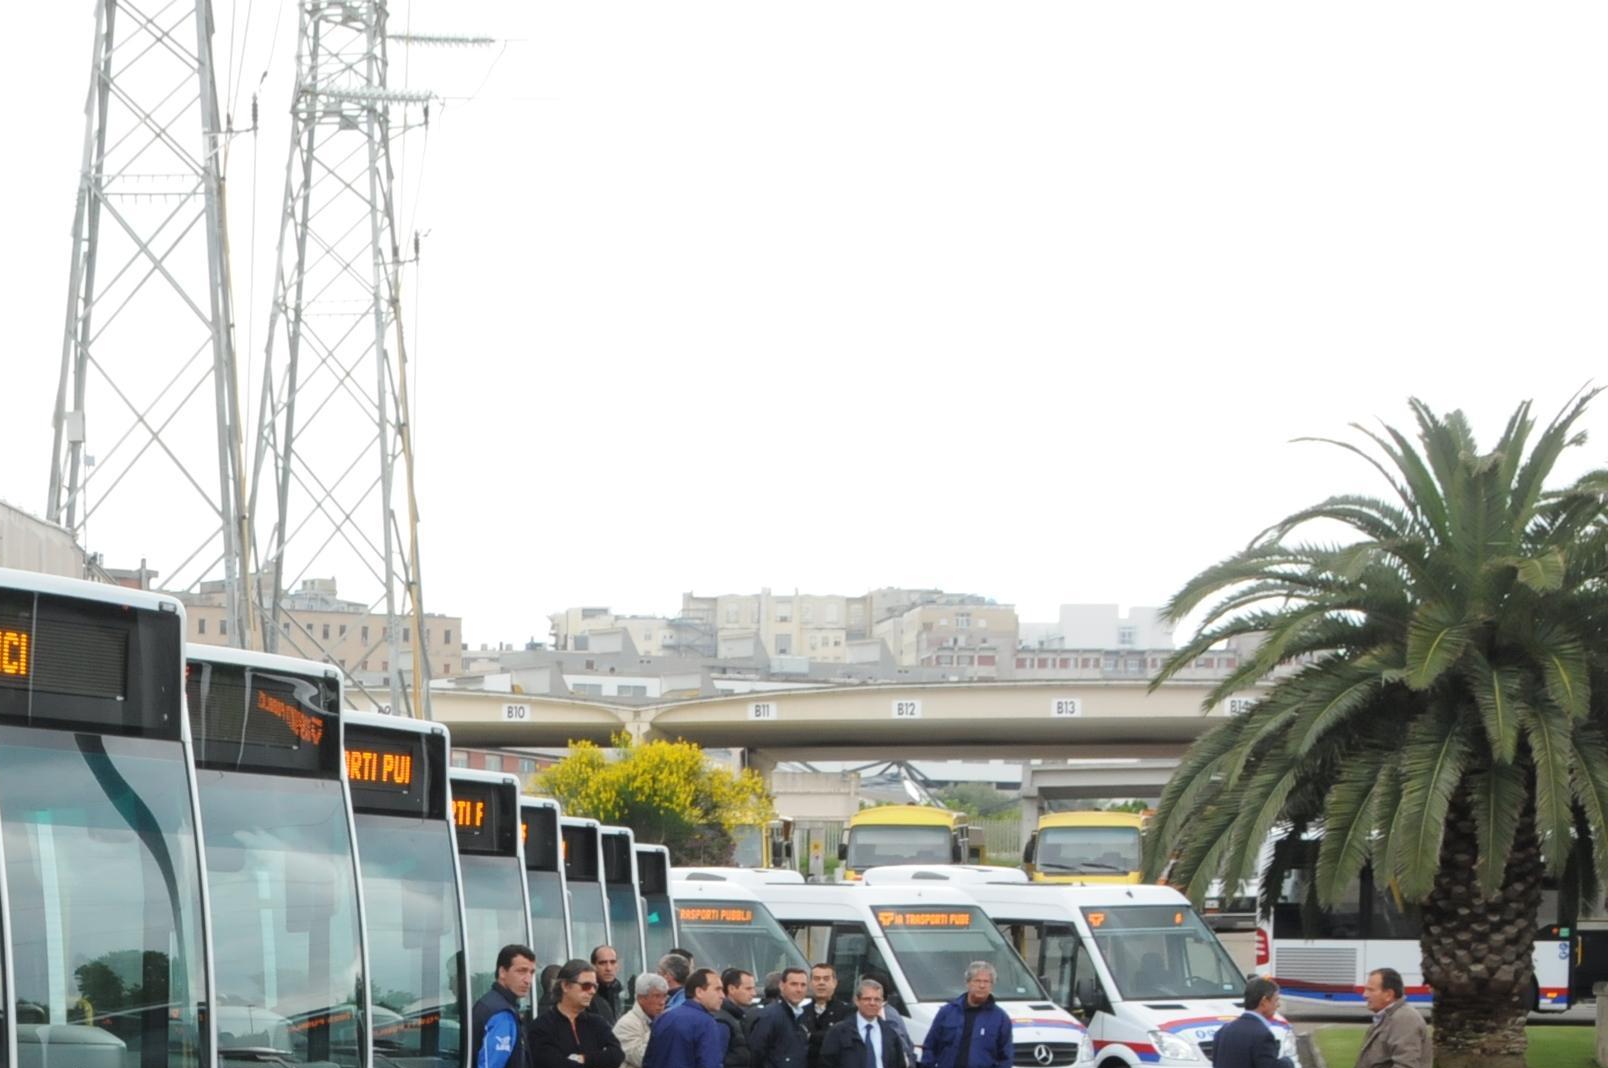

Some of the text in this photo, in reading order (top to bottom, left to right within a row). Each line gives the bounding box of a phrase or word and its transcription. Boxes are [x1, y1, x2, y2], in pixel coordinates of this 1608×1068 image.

[507, 705, 525, 719] B10
[754, 704, 770, 718] B11
[897, 702, 916, 716] B12
[1057, 700, 1075, 714] B13
